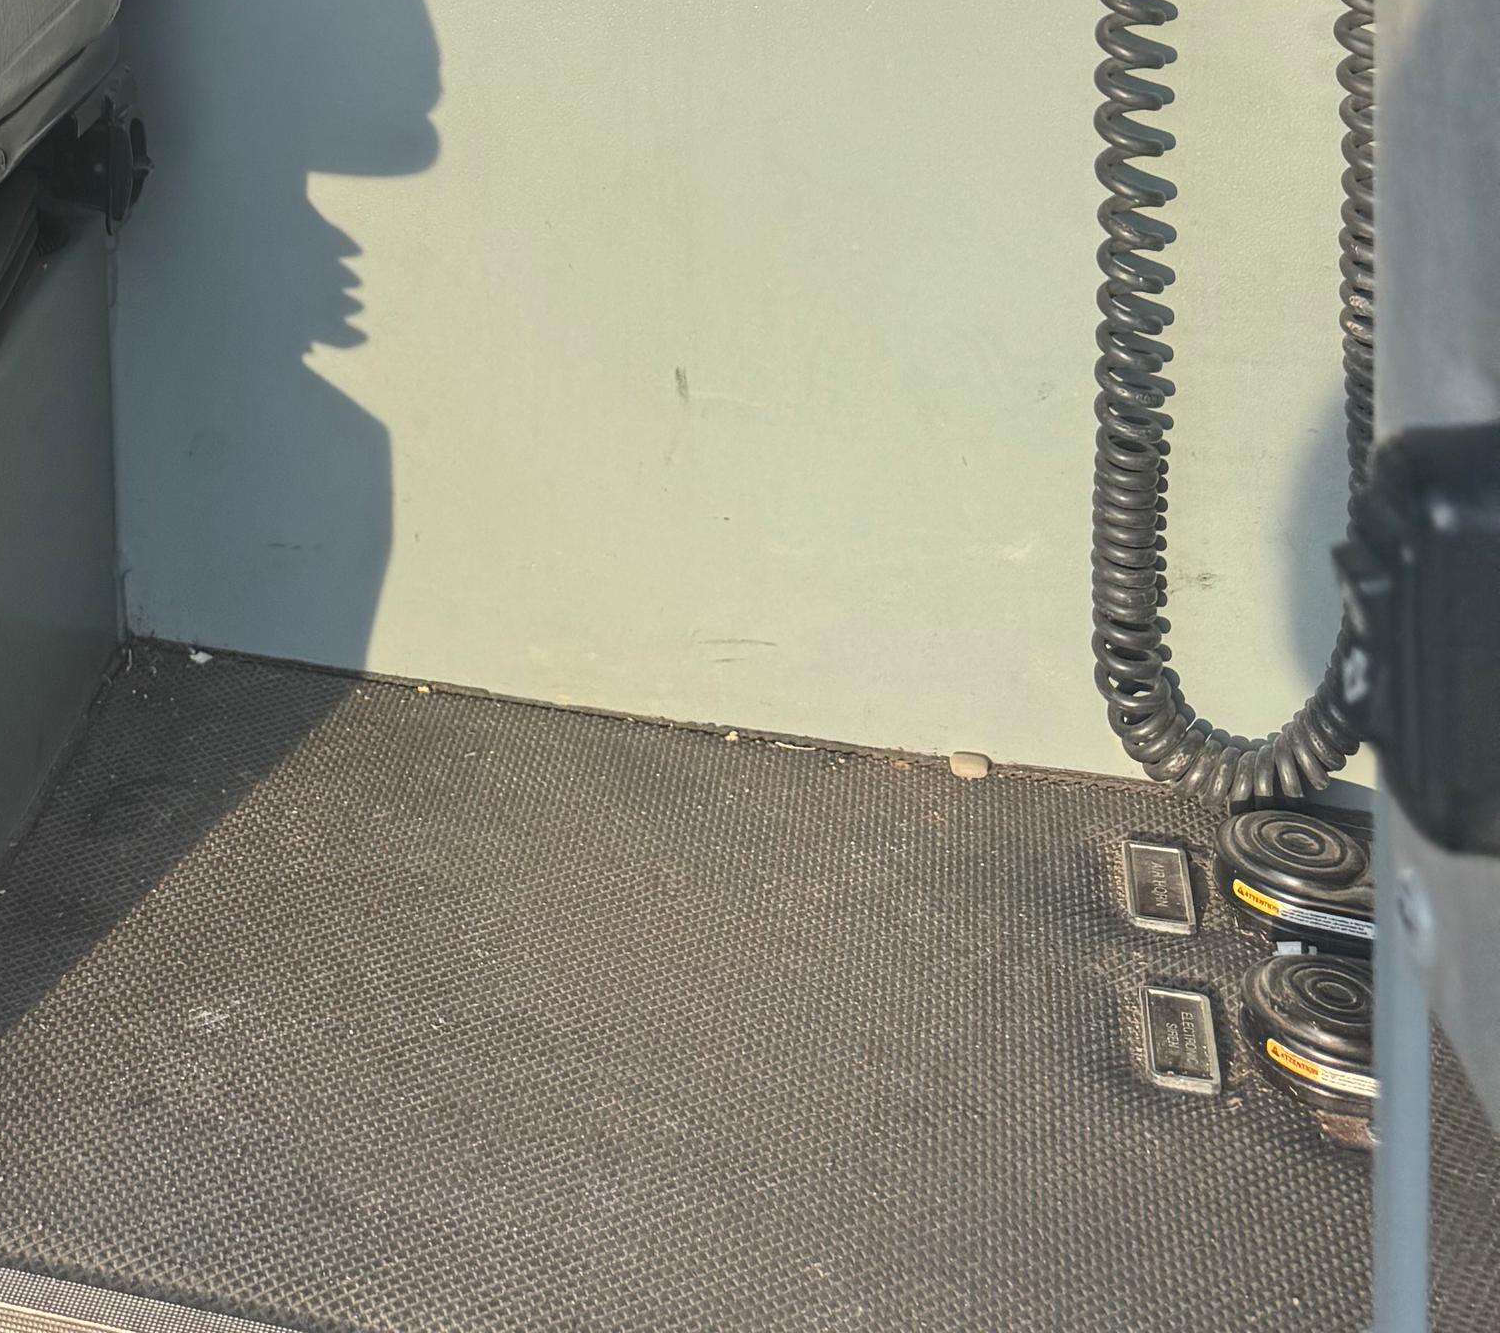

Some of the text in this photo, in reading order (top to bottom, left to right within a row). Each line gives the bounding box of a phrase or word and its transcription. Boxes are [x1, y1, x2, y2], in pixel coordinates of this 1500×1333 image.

[1150, 861, 1169, 908] AIR HORN
[1166, 1022, 1180, 1049] SIREN
[1181, 1011, 1198, 1065] ELECTRONIC
